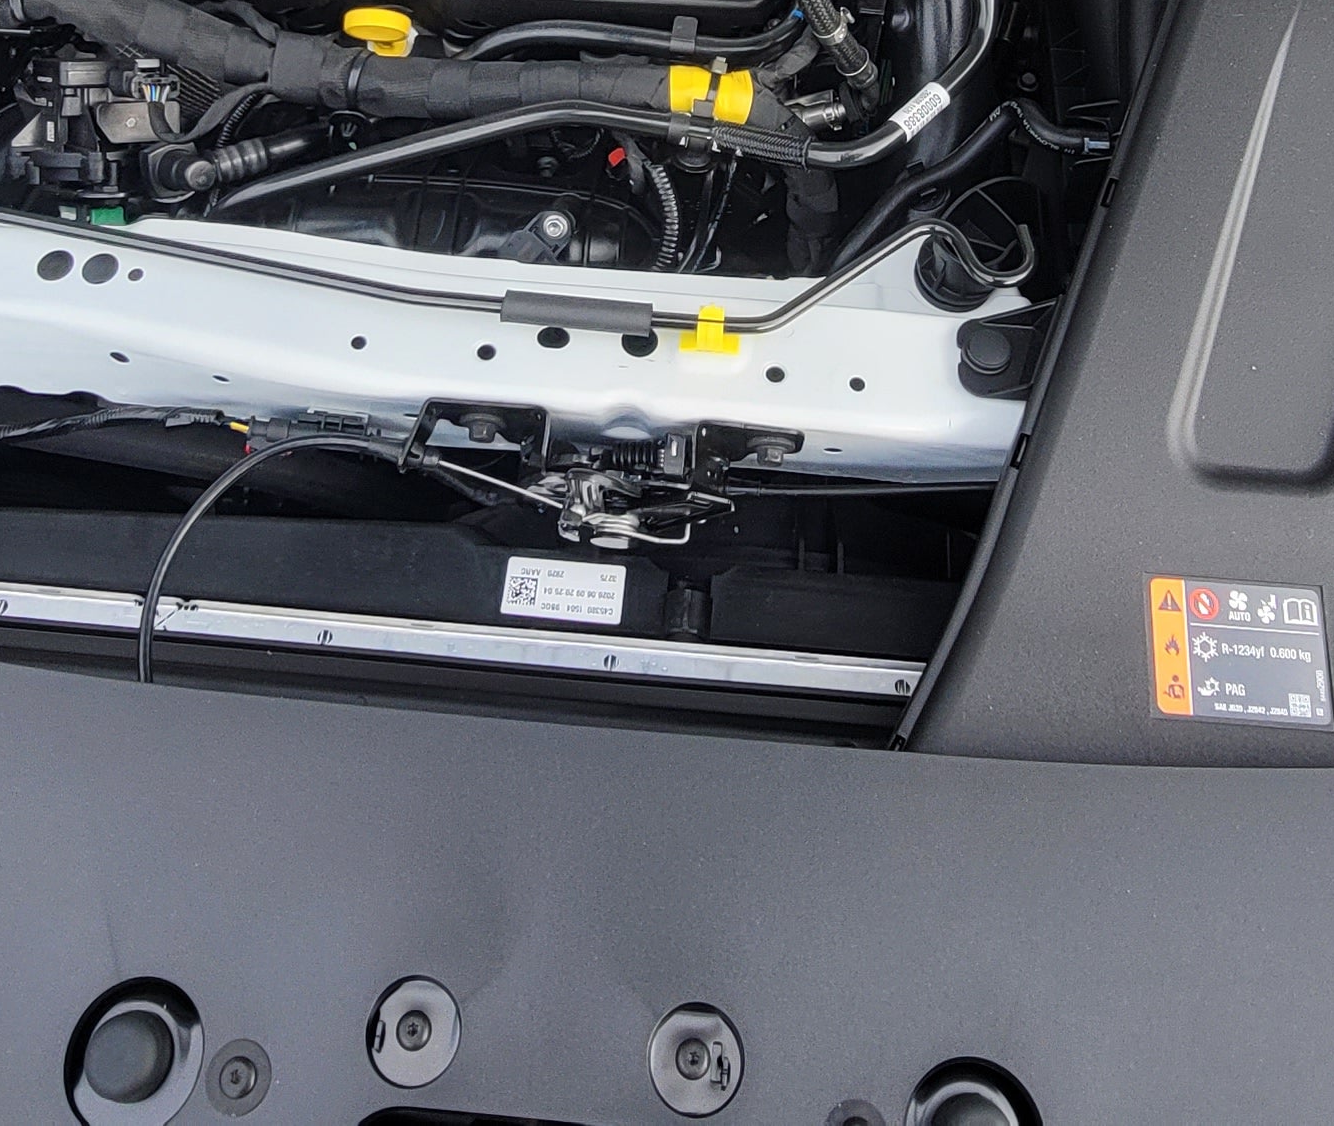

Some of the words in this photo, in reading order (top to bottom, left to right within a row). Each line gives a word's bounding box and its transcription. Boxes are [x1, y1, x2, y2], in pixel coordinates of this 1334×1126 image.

[1228, 611, 1251, 622] AUTO
[1221, 642, 1265, 660] R-1234yf
[1269, 647, 1297, 659] 0.600
[1299, 649, 1312, 663] kg
[1225, 682, 1246, 696] PAG
